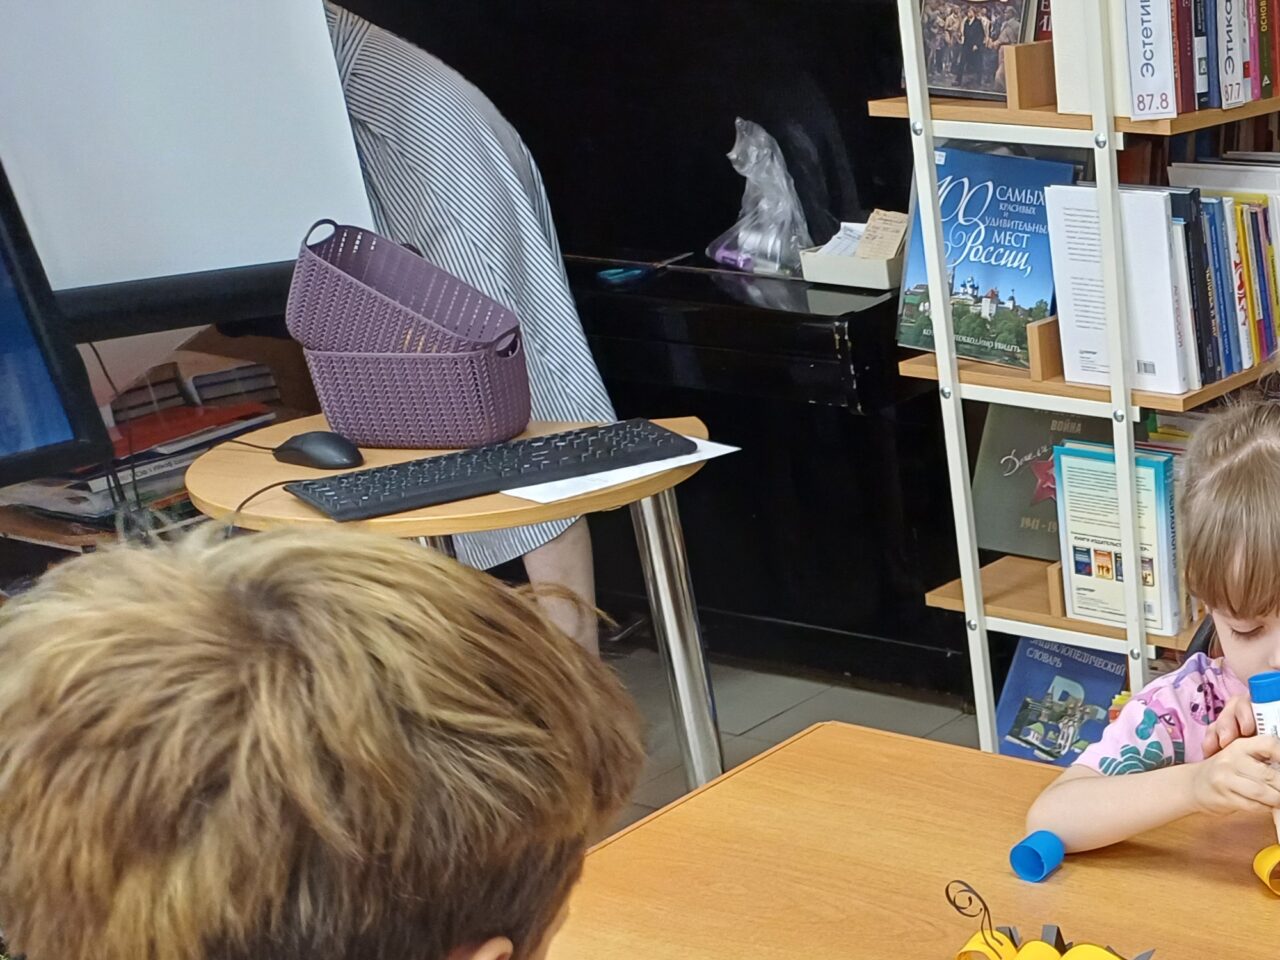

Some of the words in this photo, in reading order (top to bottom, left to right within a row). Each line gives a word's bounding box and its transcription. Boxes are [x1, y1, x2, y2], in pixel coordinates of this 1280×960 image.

[1137, 92, 1169, 111] 87.8
[1224, 83, 1241, 102] 87.7
[996, 185, 1046, 206] САМЫХ
[999, 202, 1037, 215] КРАСИВЫХ
[985, 216, 1049, 234] УДИВИТЕЛЬНЫ
[992, 231, 1030, 248] МЕСТ
[1051, 419, 1082, 434] ВОЙНА
[1026, 647, 1063, 668] СЛОВАРЬ
